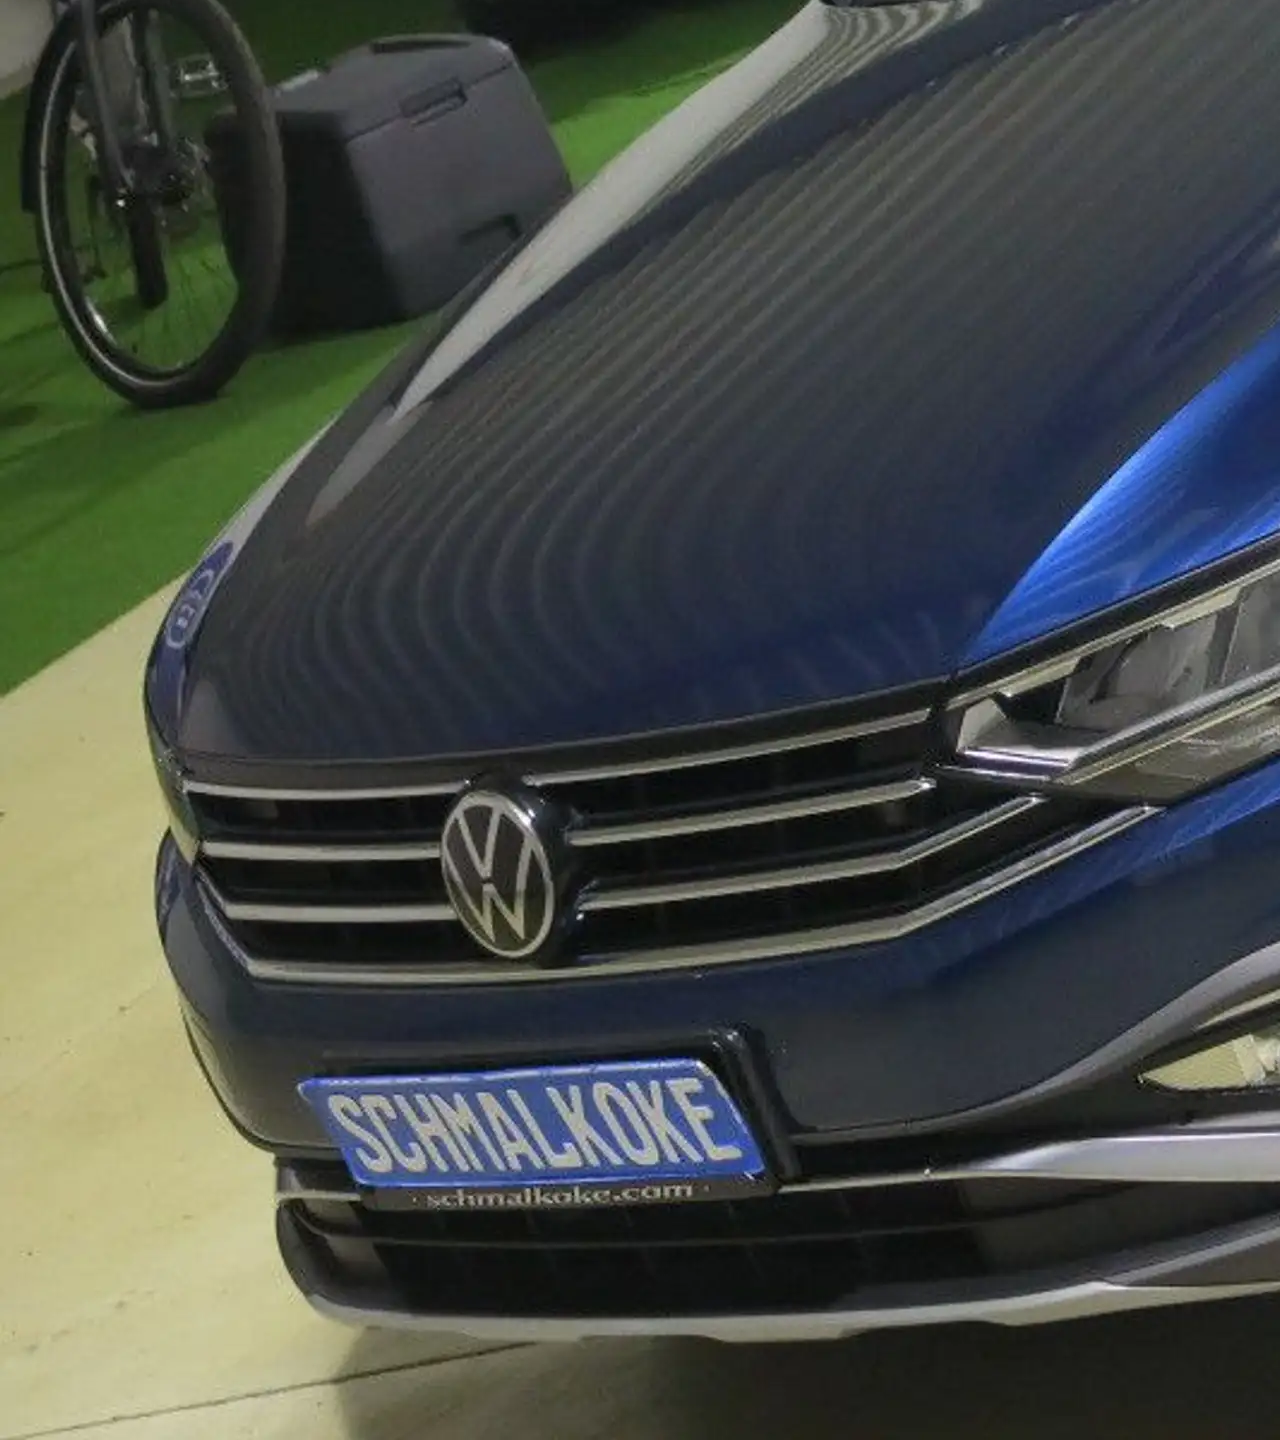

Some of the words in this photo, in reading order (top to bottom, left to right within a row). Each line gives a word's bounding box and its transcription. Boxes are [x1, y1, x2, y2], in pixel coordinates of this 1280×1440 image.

[441, 792, 555, 958] VW
[327, 1077, 743, 1175] SCHMALKOKE
[426, 1184, 694, 1209] schmalkoke.com
